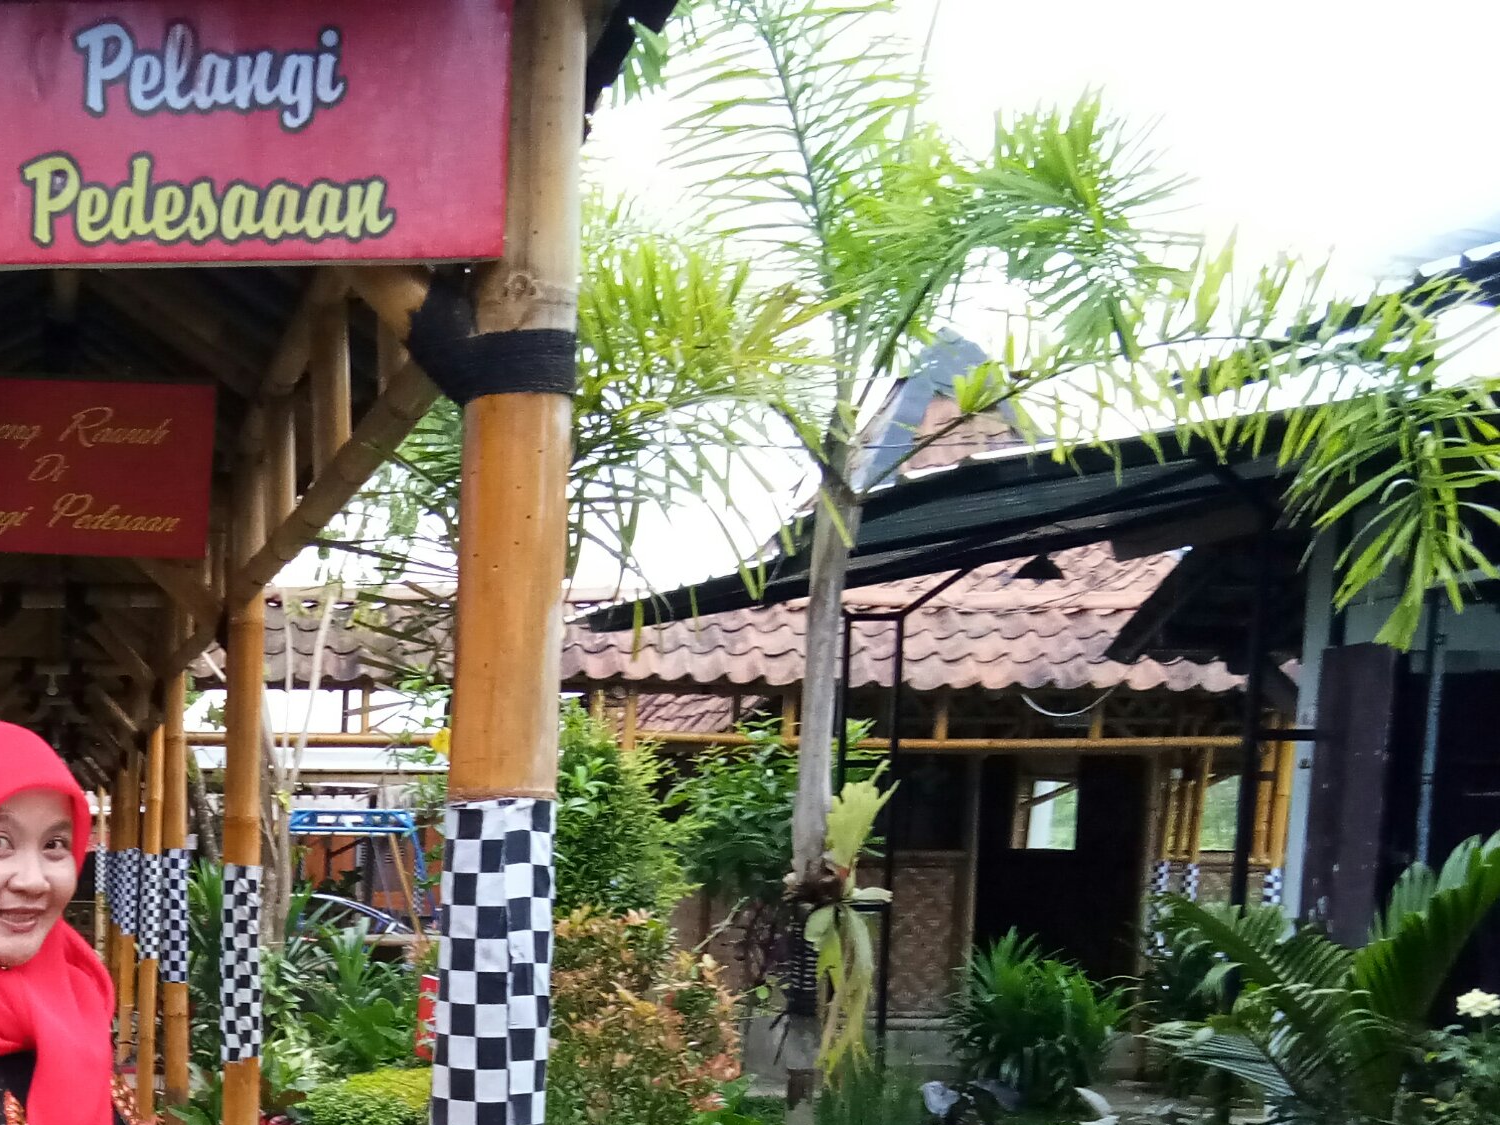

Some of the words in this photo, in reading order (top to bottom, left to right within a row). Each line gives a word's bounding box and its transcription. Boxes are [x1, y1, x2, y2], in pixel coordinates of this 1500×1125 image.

[74, 20, 346, 131] Pelangi
[21, 152, 396, 246] Pedesaaan
[27, 453, 71, 482] Di
[48, 493, 181, 532] Pedesaan
